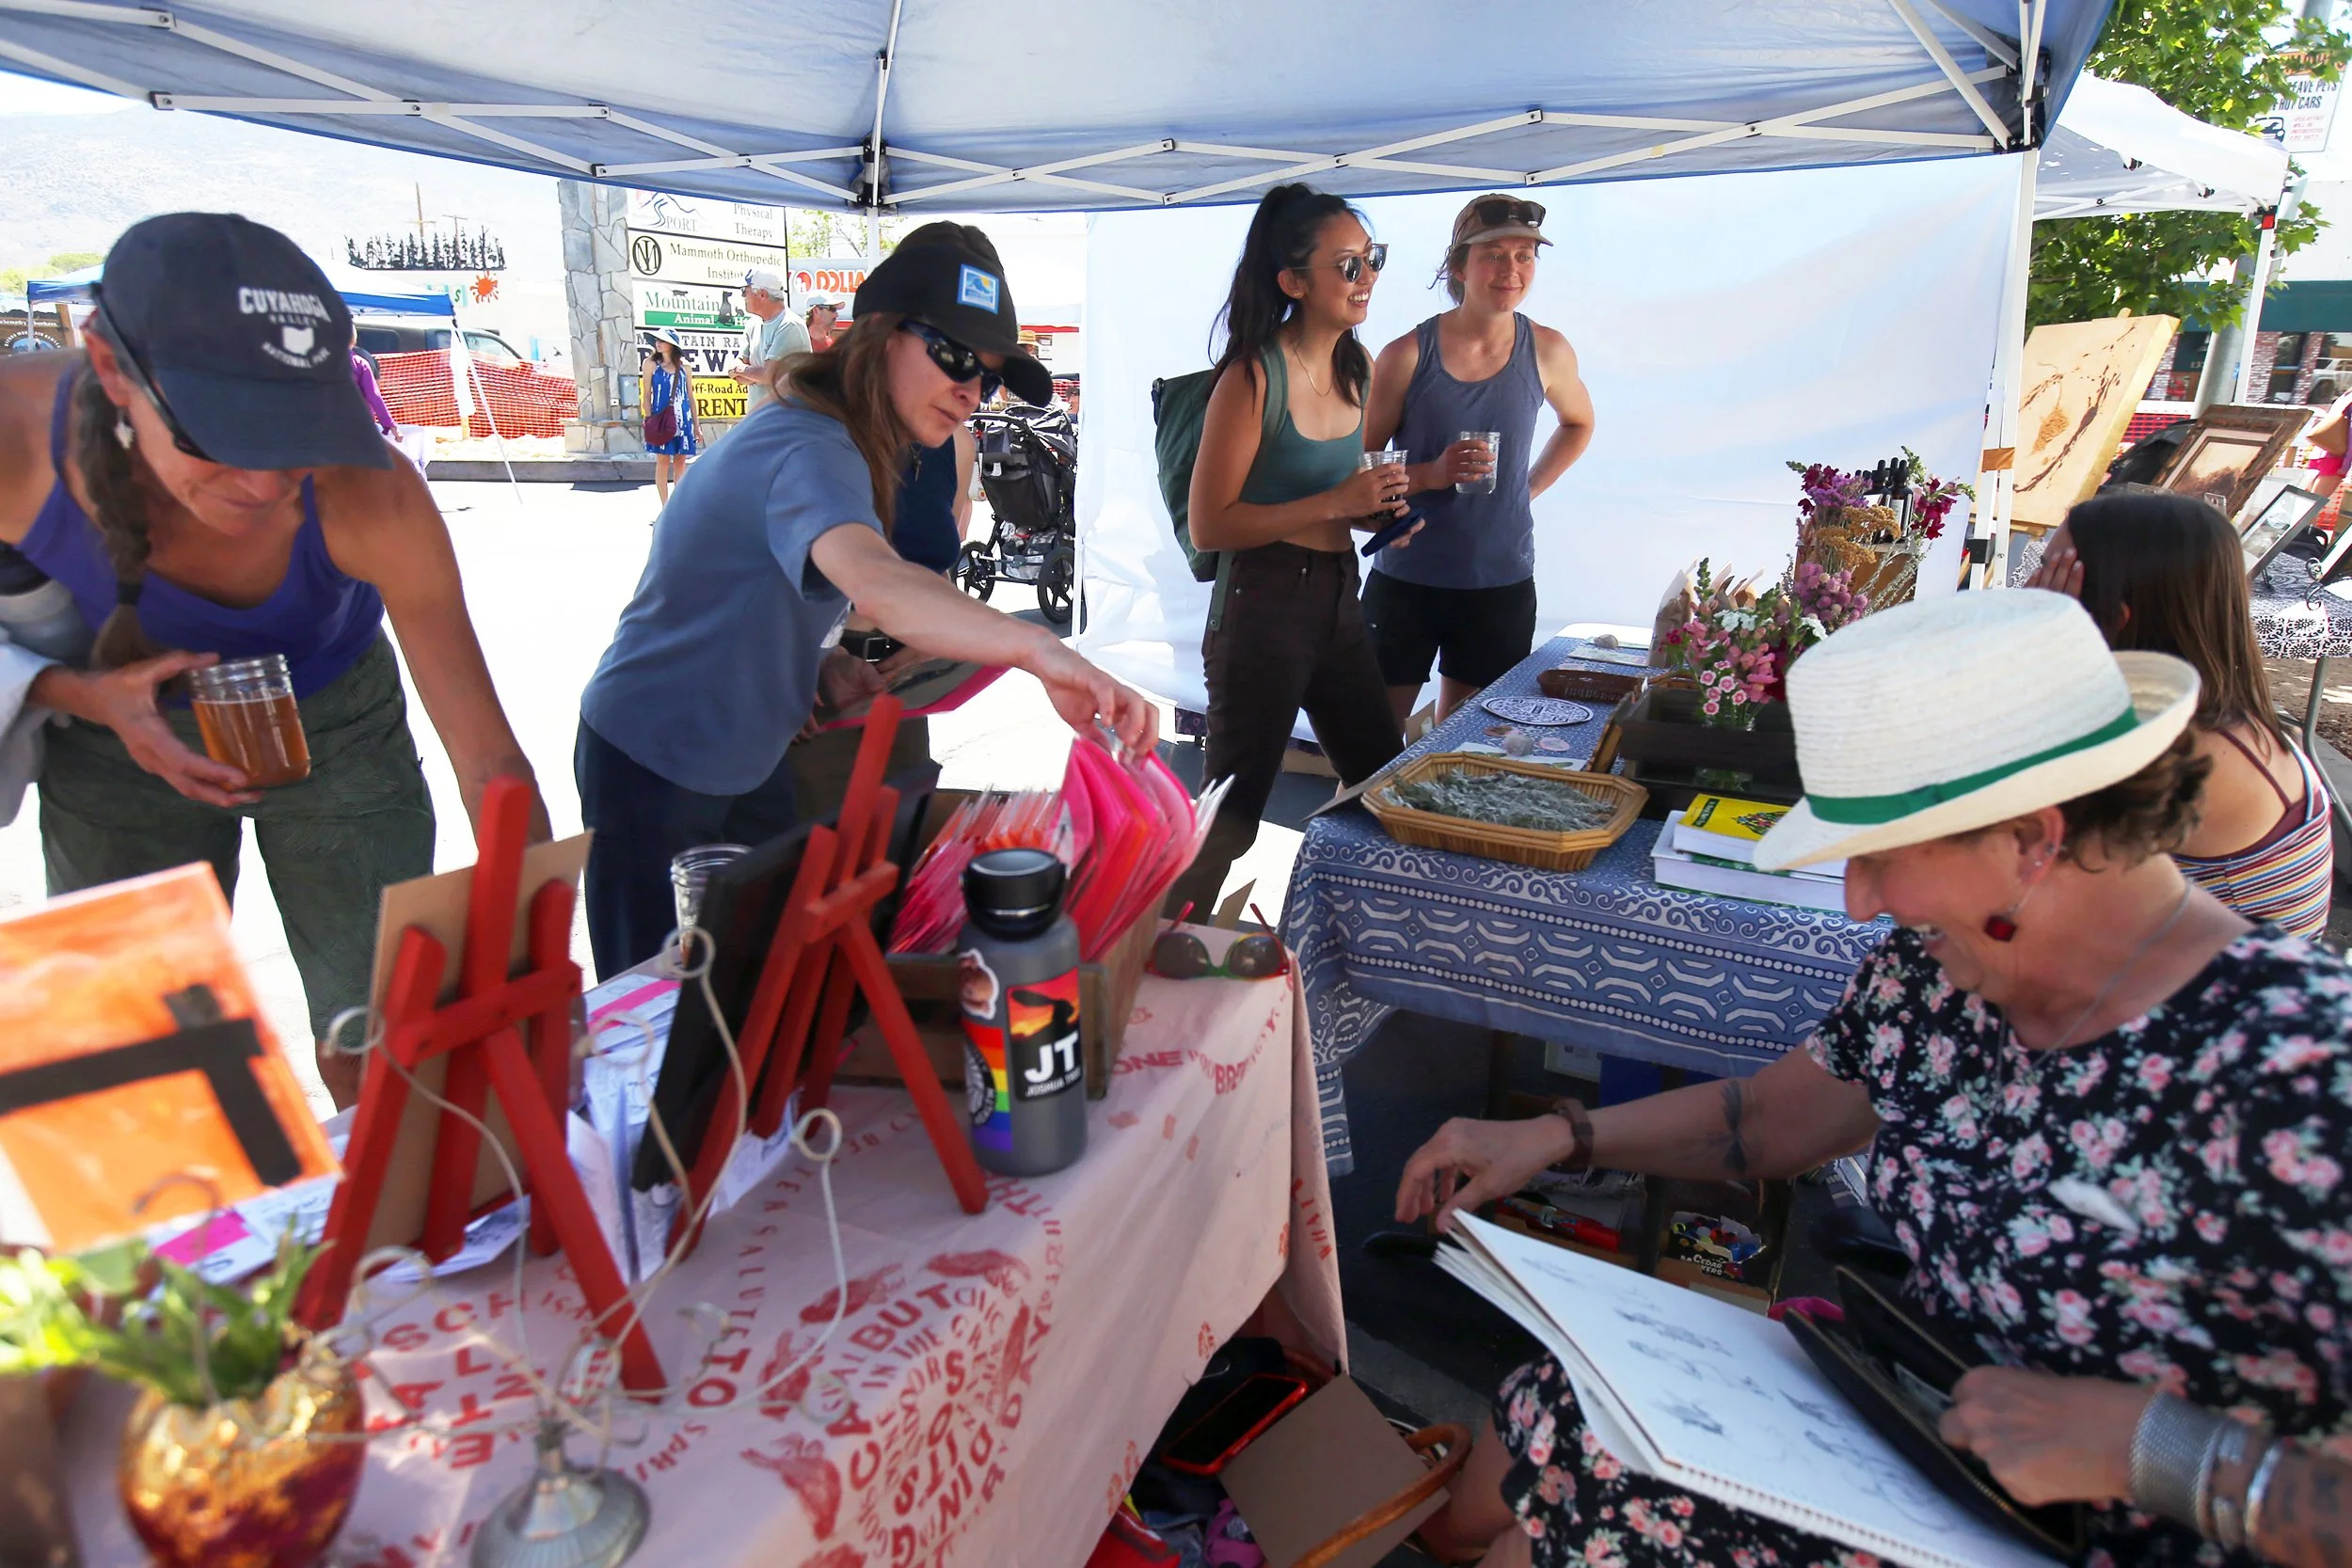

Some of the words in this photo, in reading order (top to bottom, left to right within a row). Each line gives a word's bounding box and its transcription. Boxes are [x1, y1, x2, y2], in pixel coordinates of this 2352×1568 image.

[2298, 95, 2323, 110] CARS
[734, 202, 773, 220] Physical
[735, 221, 773, 241] Therapy
[670, 243, 723, 258] Mammoth
[726, 249, 782, 266] Orthopedic
[816, 270, 866, 293] DOLLA
[644, 291, 720, 313] Mountain
[674, 313, 715, 325] Animal
[692, 383, 733, 394] ff-Road
[1024, 1030, 1079, 1083] JT
[1693, 1254, 1723, 1269] CEDAR
[850, 1283, 953, 1353] BUT
